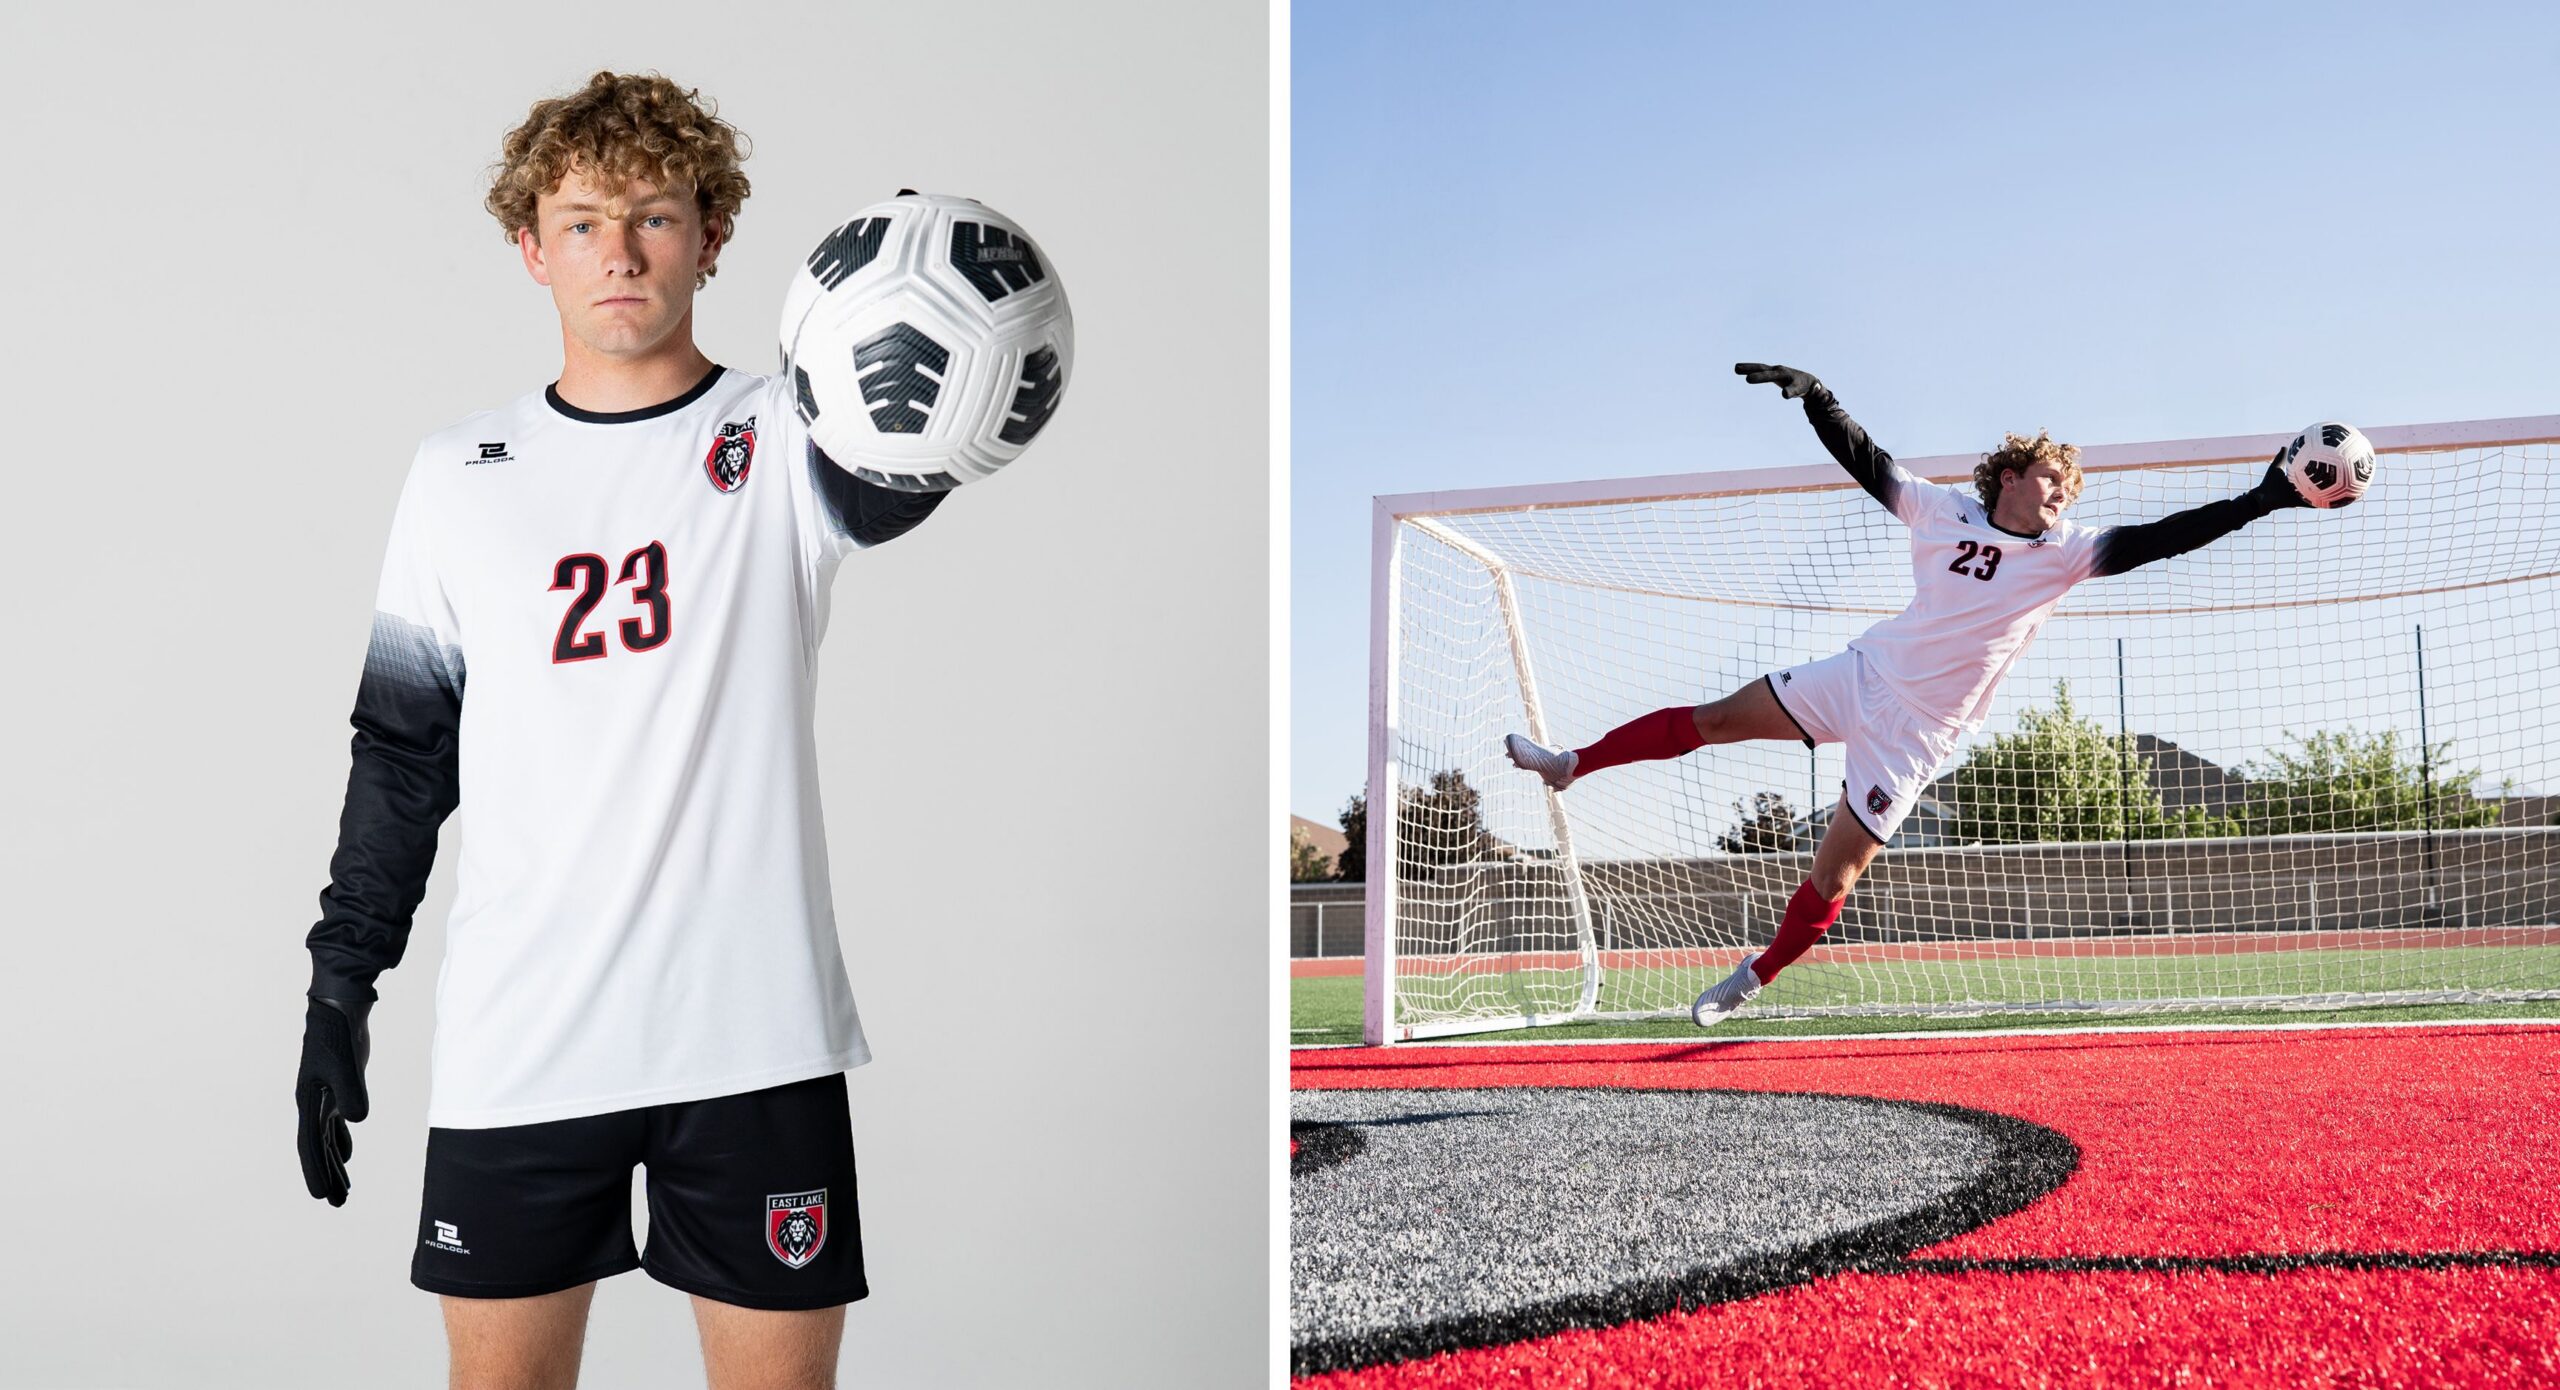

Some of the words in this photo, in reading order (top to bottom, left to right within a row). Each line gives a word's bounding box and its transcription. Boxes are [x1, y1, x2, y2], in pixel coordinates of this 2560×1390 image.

[720, 425, 733, 436] ST
[465, 456, 516, 466] PROLOOK
[1948, 540, 2002, 581] 23
[547, 540, 671, 664] 23
[772, 1198, 798, 1208] EAST
[800, 1194, 823, 1206] LAKE
[425, 1239, 471, 1255] PROLOOK
